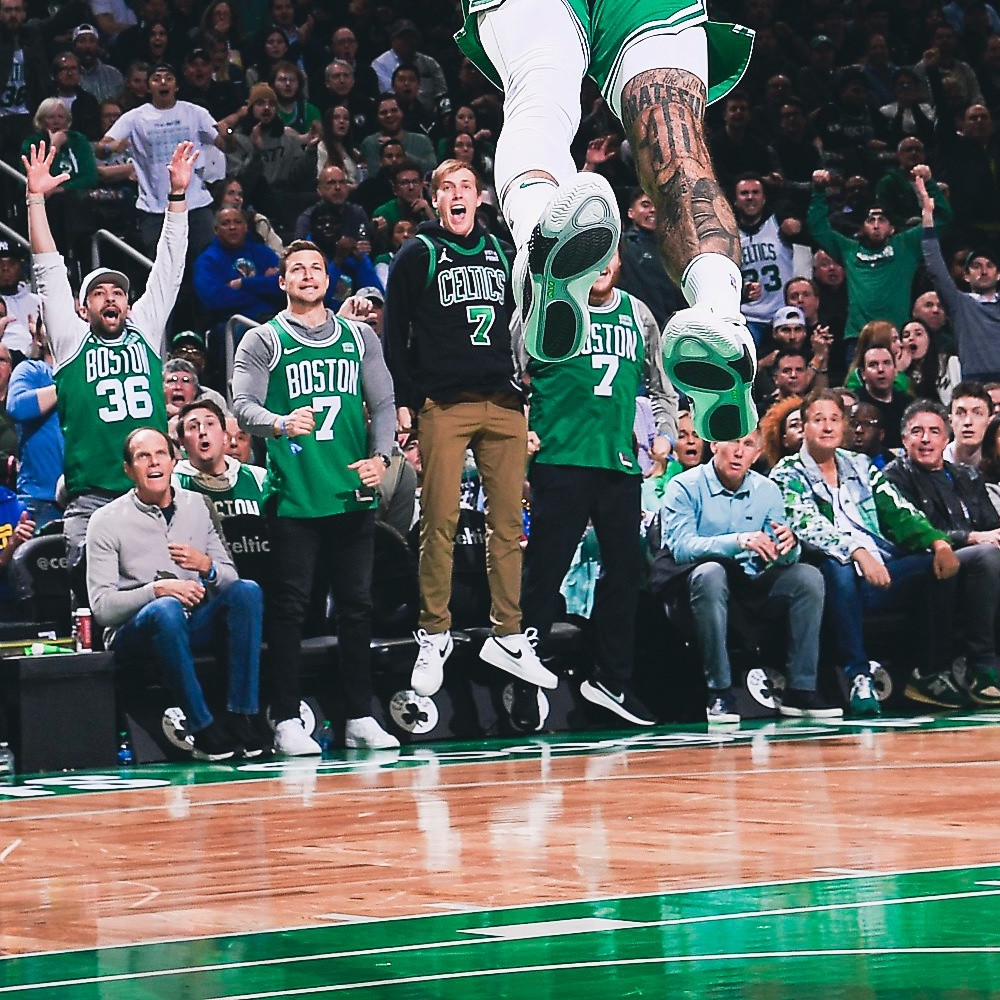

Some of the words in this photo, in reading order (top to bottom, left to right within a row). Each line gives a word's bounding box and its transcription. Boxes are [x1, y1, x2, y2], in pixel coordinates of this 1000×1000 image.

[742, 243, 777, 265] ELTICS
[438, 266, 506, 307] CELTICS
[466, 305, 496, 346] 7
[85, 341, 151, 383] BOSTON
[285, 358, 360, 400] BOSTON
[591, 354, 619, 396] 7
[96, 375, 153, 423] 36
[312, 395, 342, 441] 7
